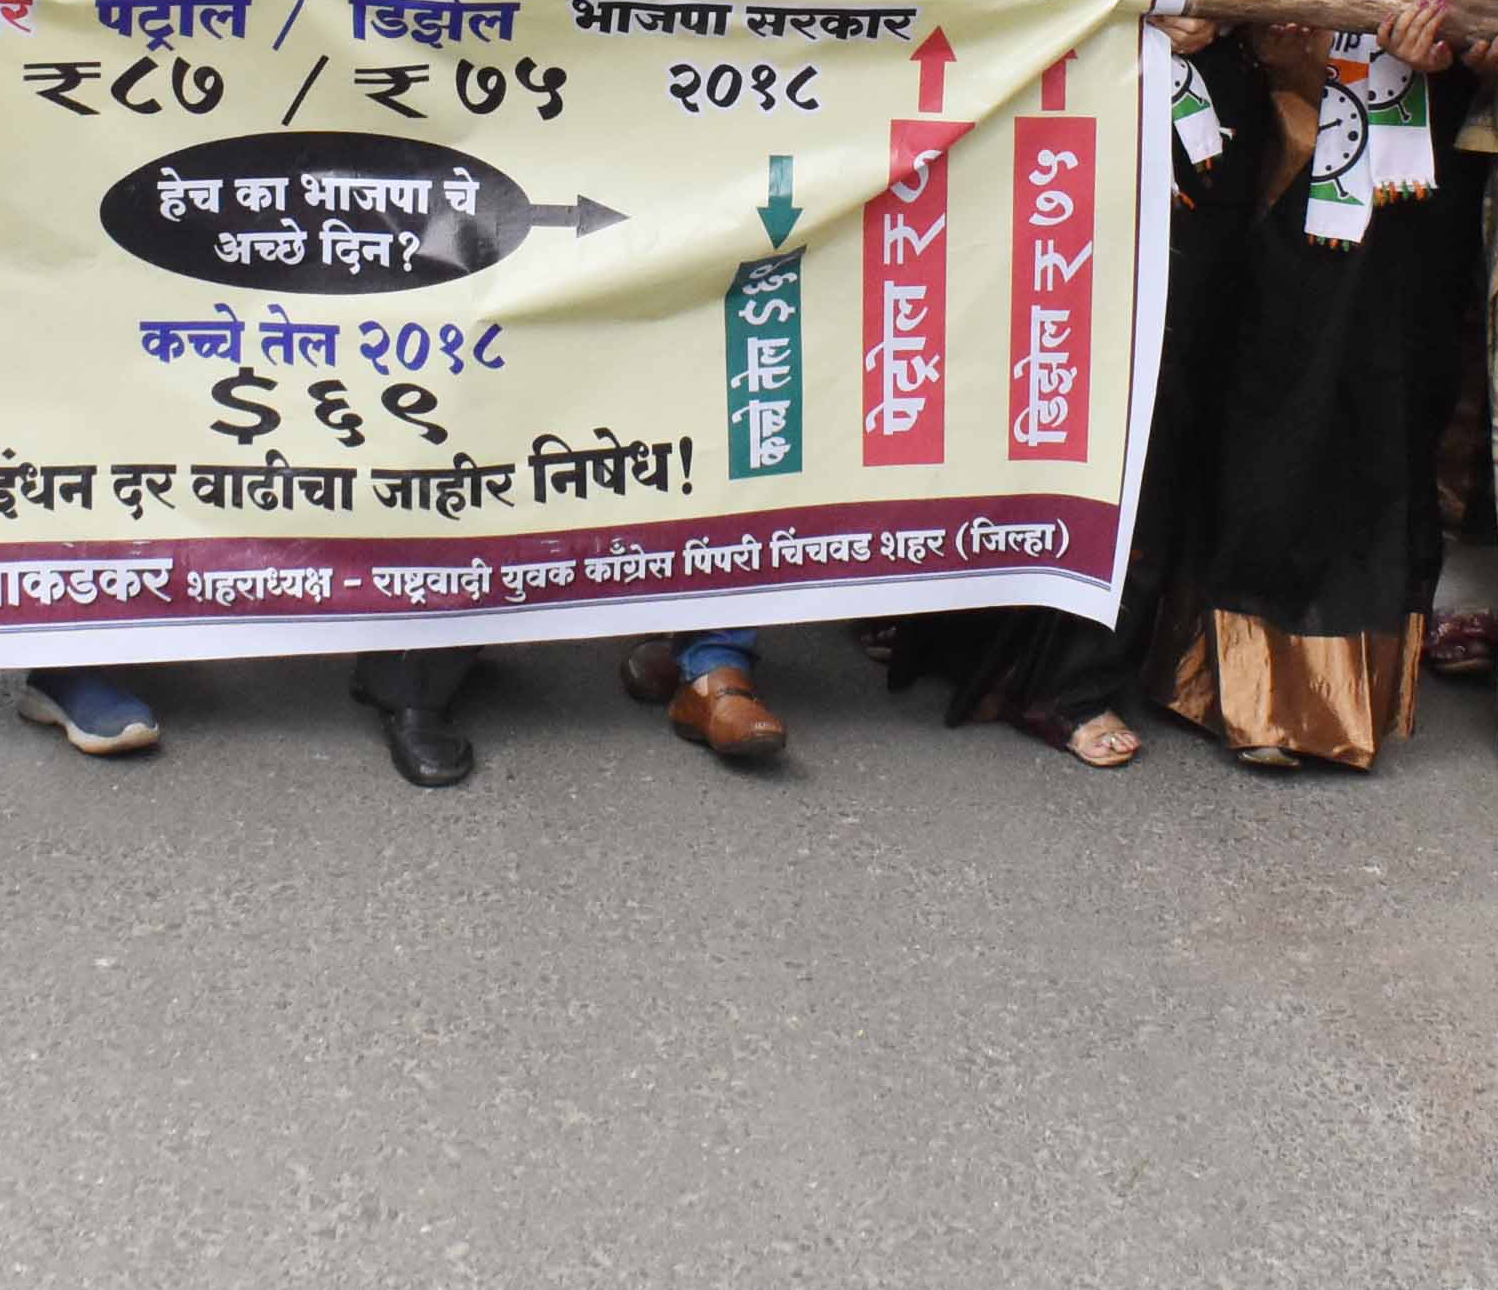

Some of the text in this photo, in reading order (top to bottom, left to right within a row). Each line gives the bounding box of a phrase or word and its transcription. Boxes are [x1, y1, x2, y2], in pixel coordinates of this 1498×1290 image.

[746, 6, 916, 40] सरकार
[669, 64, 819, 111] २०१८
[157, 167, 479, 222] हेच का भाजपा चे
[214, 218, 420, 274] अच्छे दिन?
[140, 303, 505, 375] कच्चे तेल २०१८
[731, 337, 790, 391] तेल
[866, 280, 940, 435] पेट्रोल
[1014, 305, 1077, 447] डिझेल
[112, 463, 176, 521] दर
[191, 449, 356, 511] वाढीचा
[373, 453, 516, 521] जाहीर
[529, 428, 693, 504] निषेध!
[187, 566, 333, 607] शहराध्यक्ष
[373, 558, 492, 604] राष्ट्रवादी
[501, 559, 576, 603] युवक
[683, 533, 761, 576] पिंपरी
[769, 527, 872, 568] चिंचवड
[880, 527, 945, 564] शहर
[955, 516, 1070, 560] (जिल्हा)
